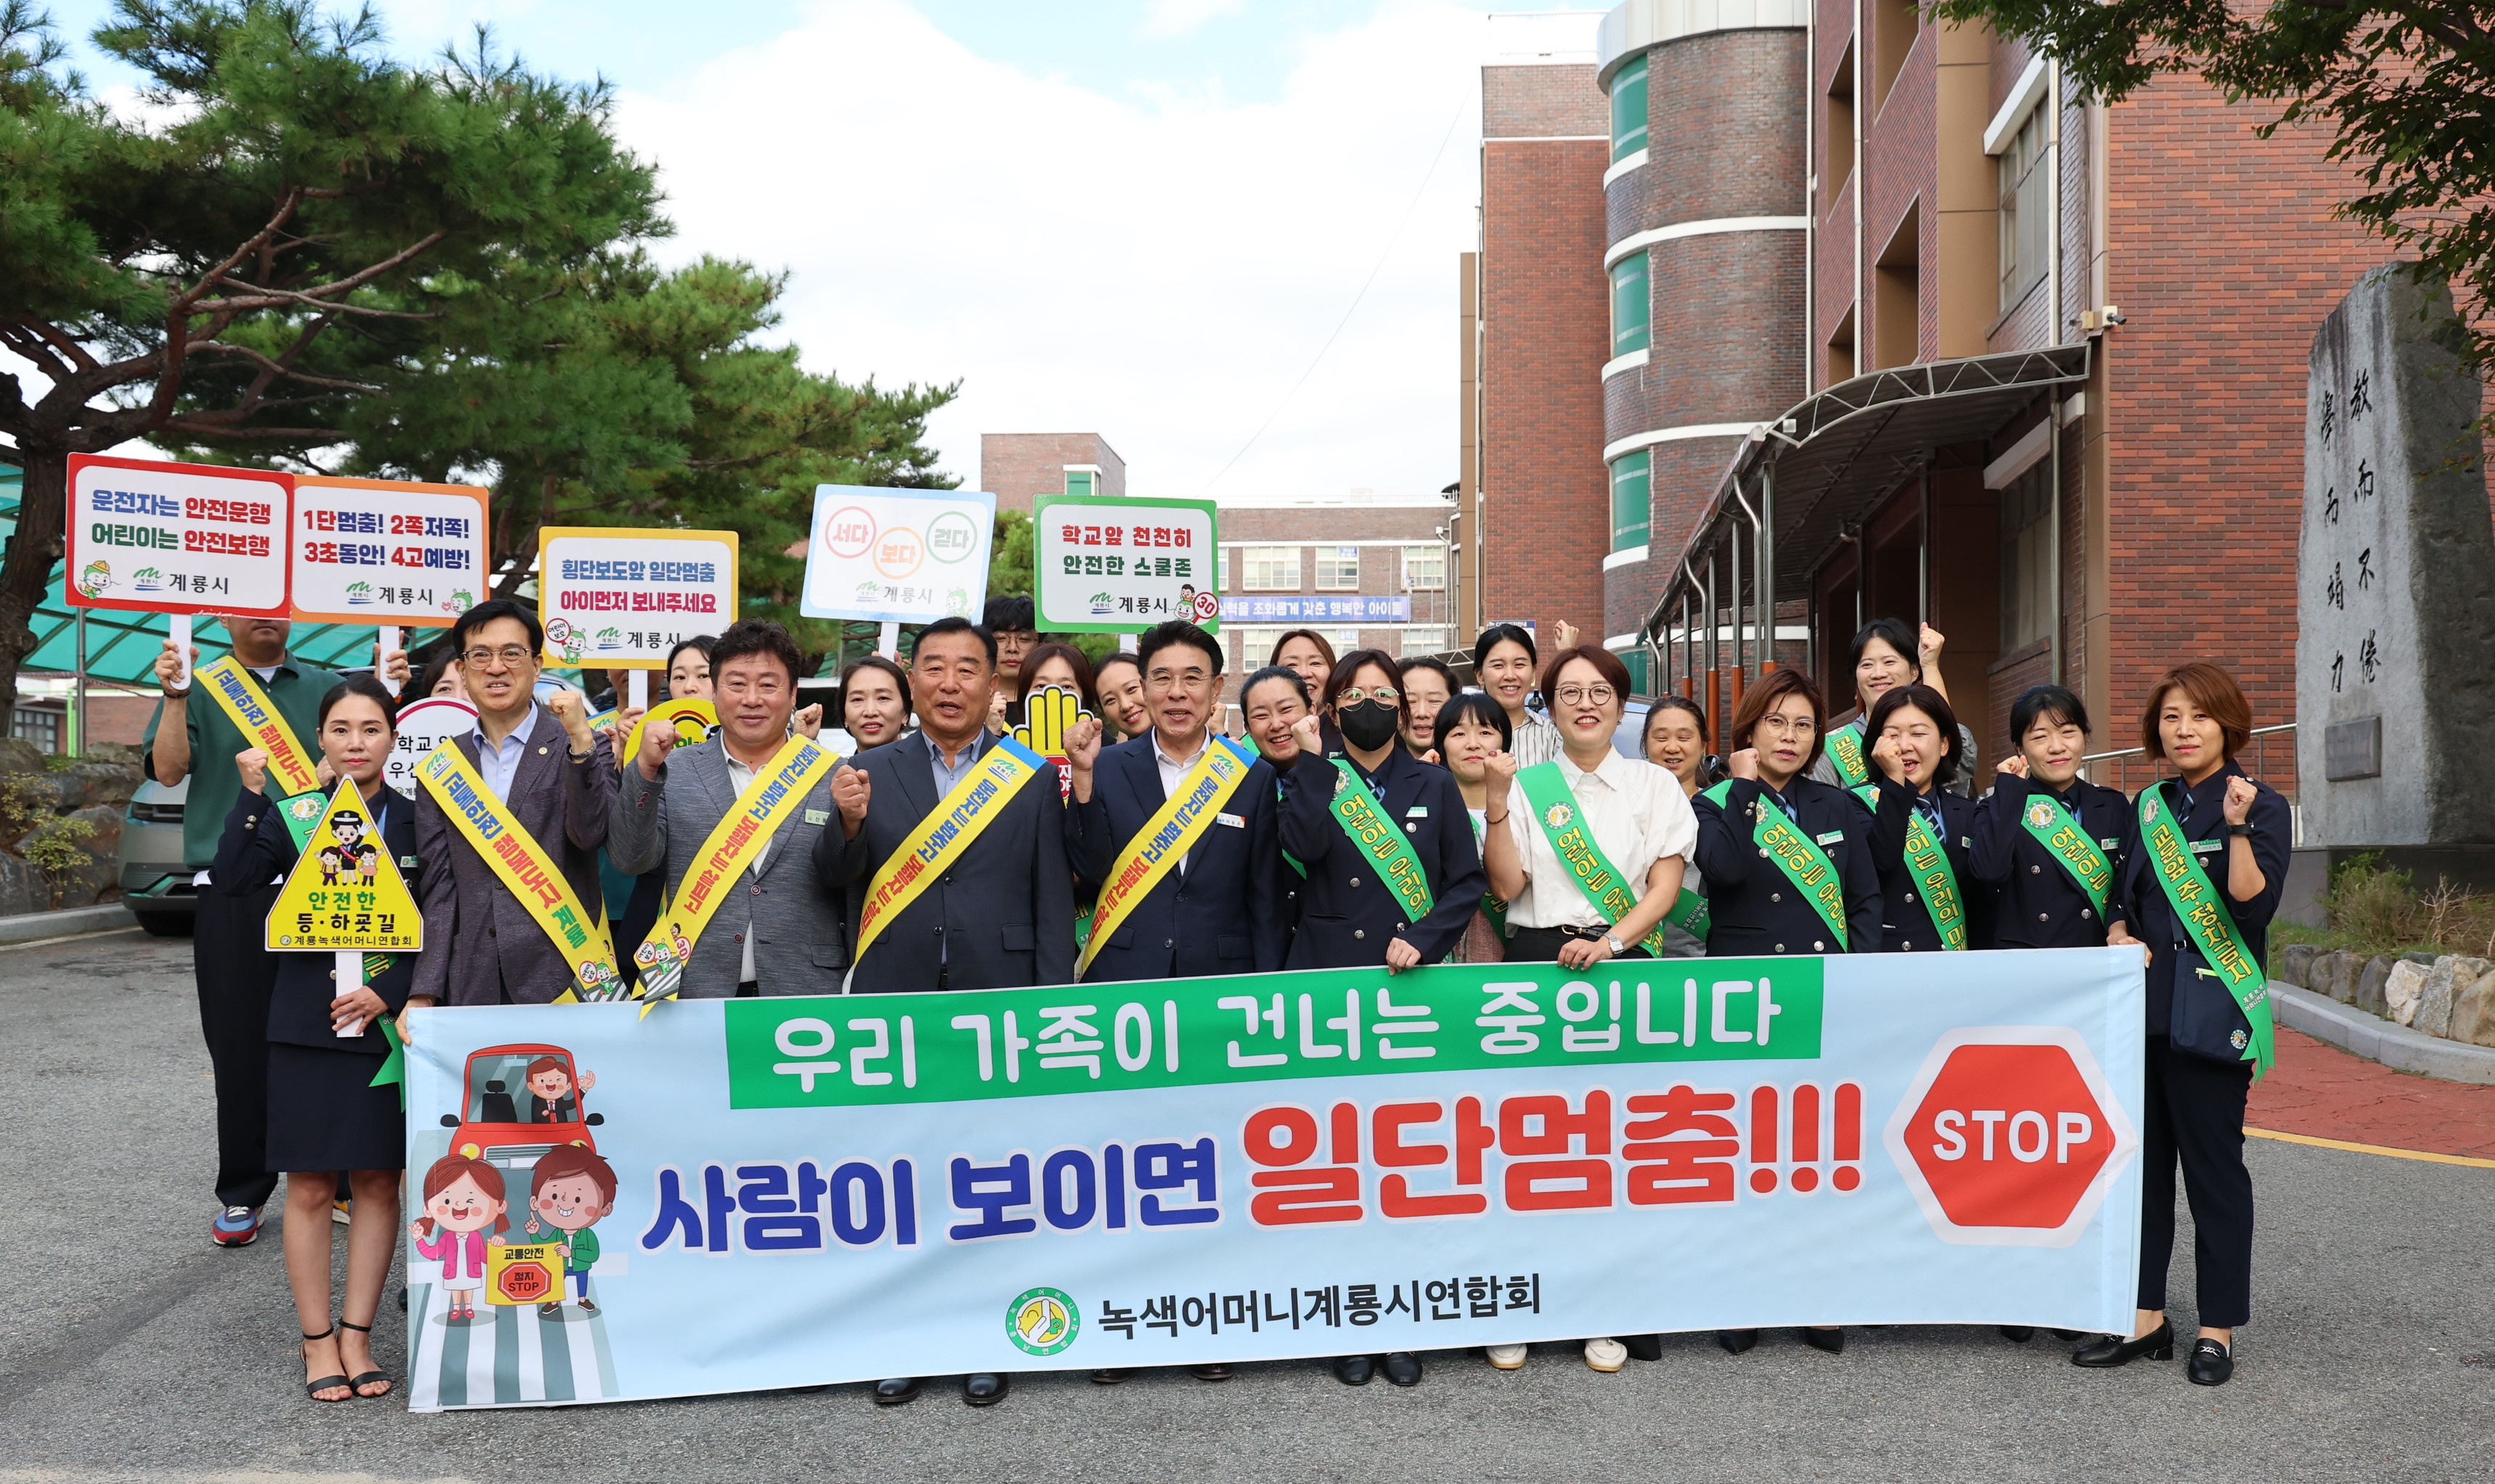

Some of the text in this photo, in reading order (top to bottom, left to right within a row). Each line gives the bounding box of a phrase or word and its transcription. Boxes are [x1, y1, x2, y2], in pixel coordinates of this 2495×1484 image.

[92, 490, 271, 524] 운전자는 안전운행
[304, 510, 469, 539] 1단멈춤! 2쪽저쪽!
[832, 523, 869, 543] 서다
[934, 528, 969, 548] 걷다
[1062, 524, 1191, 548] 학교앞 천천히
[92, 523, 269, 557] 어린이는 안전보행
[880, 543, 917, 564] 보다
[304, 542, 469, 570] 3초동안! 4고예방!
[1063, 554, 1192, 578] 안전한 스쿨존
[169, 573, 229, 594] 계룡시
[561, 559, 715, 583] 횡단보도앞 일단멈춤
[379, 587, 432, 605] 계룡시
[561, 591, 716, 614] 아이먼저 보내주세요
[883, 586, 933, 604] 계룡시
[1119, 597, 1167, 614] 계룡시
[1197, 596, 1216, 615] 30
[1253, 601, 1299, 616] 조화롭게
[1302, 601, 1326, 616] 갖춘
[1330, 601, 1365, 616] 행복한
[1368, 601, 1403, 616] 아이들
[548, 623, 567, 633] 어린이
[553, 631, 566, 639] 보호
[628, 632, 681, 649] 계룡시
[213, 668, 269, 727] 교통안전
[259, 723, 312, 791] 행복도시
[397, 736, 432, 753] 학교
[1833, 735, 1866, 779] 교문앞
[779, 743, 821, 787] 운전자는
[749, 779, 782, 822] 멈추고
[952, 778, 999, 828] 운전자는
[1175, 776, 1219, 828] 운전자는
[711, 815, 758, 872] 보행자는
[917, 818, 960, 864] 멈추고
[1141, 819, 1183, 864] 멈추고
[1339, 793, 1427, 915] 어린이는 우리의
[1763, 823, 1827, 887] 어린이는
[2151, 823, 2183, 883] 교문앞
[441, 771, 588, 949] 교통안전 행복도시 계룡
[1557, 827, 1612, 893] 어린이는
[2051, 825, 2109, 892] 어린이는
[683, 870, 721, 915] 살피고
[877, 853, 925, 908] 보행자는
[1105, 856, 1150, 912] 보행자는
[308, 891, 376, 911] 안전한
[1926, 872, 1959, 925] 우리의
[296, 913, 395, 933] 등·하굣길
[294, 936, 412, 946] 계룡녹색어머니연합회
[677, 940, 688, 957] 30
[772, 976, 1782, 1093] 우리 가족이 건너는 중입니다
[1933, 1109, 2093, 1164] STOP
[641, 1082, 1862, 1253] 사람이 보이면 일단멈춤!!!
[504, 1248, 544, 1260] 교통안전
[508, 1282, 539, 1292] STOP
[514, 1272, 534, 1281] 정지
[1098, 1273, 1541, 1341] 녹색어머니계룡시연합회
